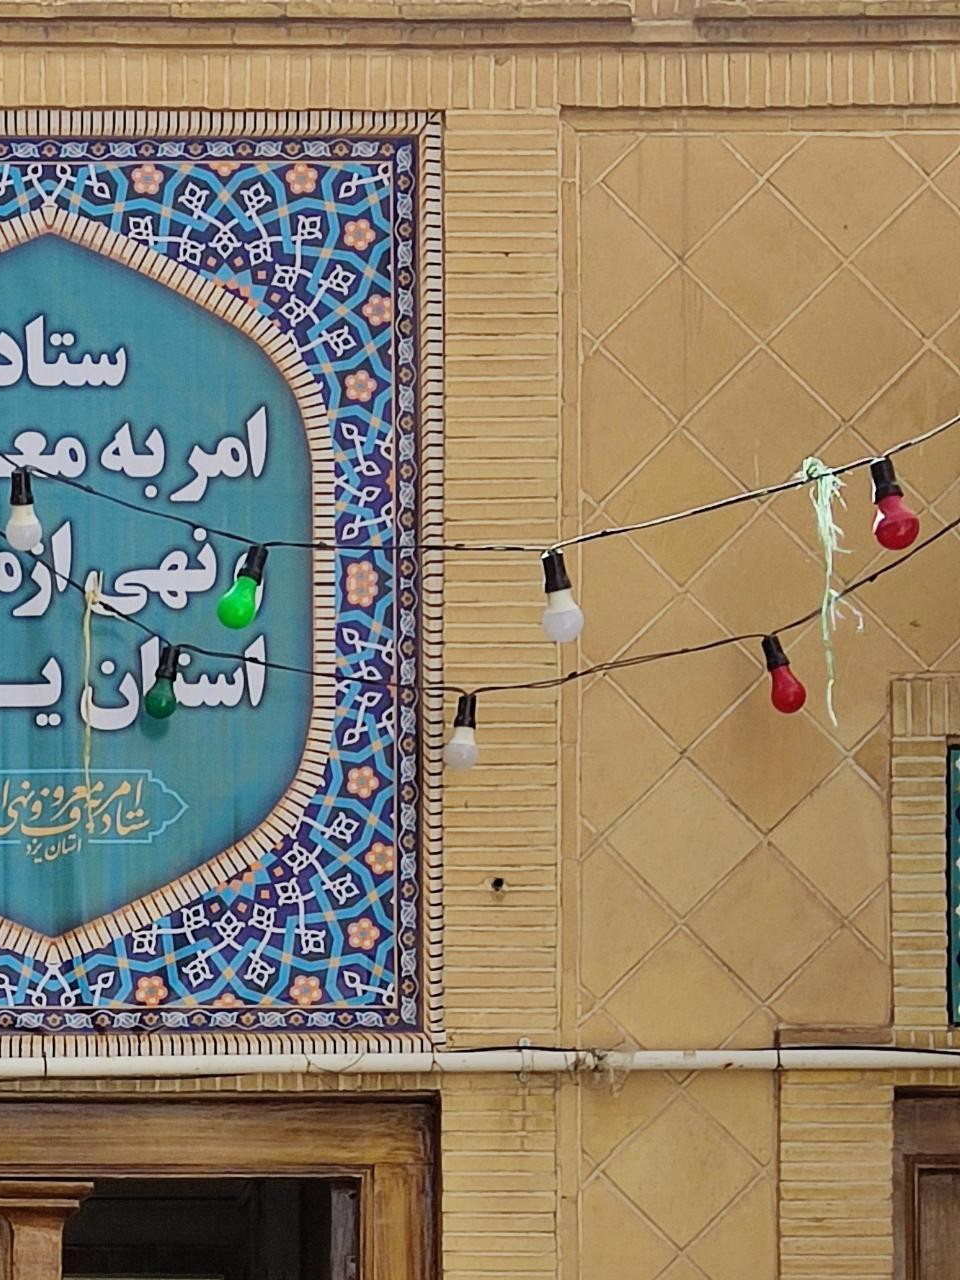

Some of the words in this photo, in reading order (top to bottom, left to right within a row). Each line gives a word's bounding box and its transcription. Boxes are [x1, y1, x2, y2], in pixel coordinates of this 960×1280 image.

[100, 422, 167, 499] به
[170, 406, 268, 502] امر
[12, 520, 73, 617] از
[84, 526, 218, 617] نهی
